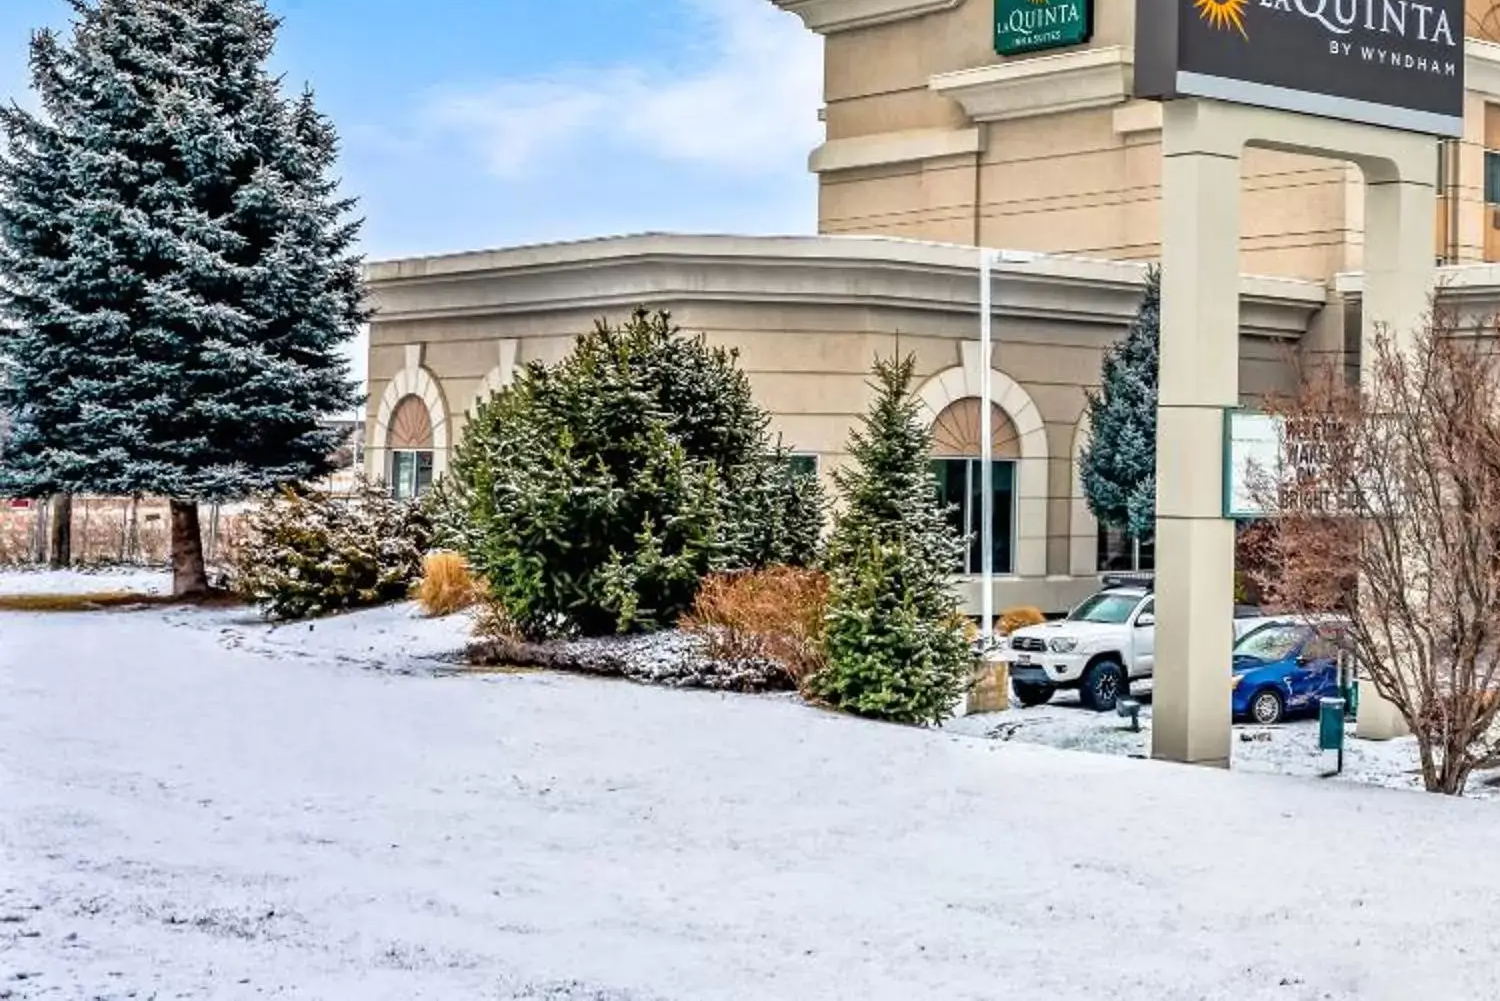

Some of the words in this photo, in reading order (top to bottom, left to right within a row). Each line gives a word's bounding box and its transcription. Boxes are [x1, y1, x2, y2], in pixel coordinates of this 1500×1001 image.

[1010, 3, 1079, 34] QUINTA
[1330, 41, 1350, 55] BY
[1361, 47, 1455, 76] WYNDHAM
